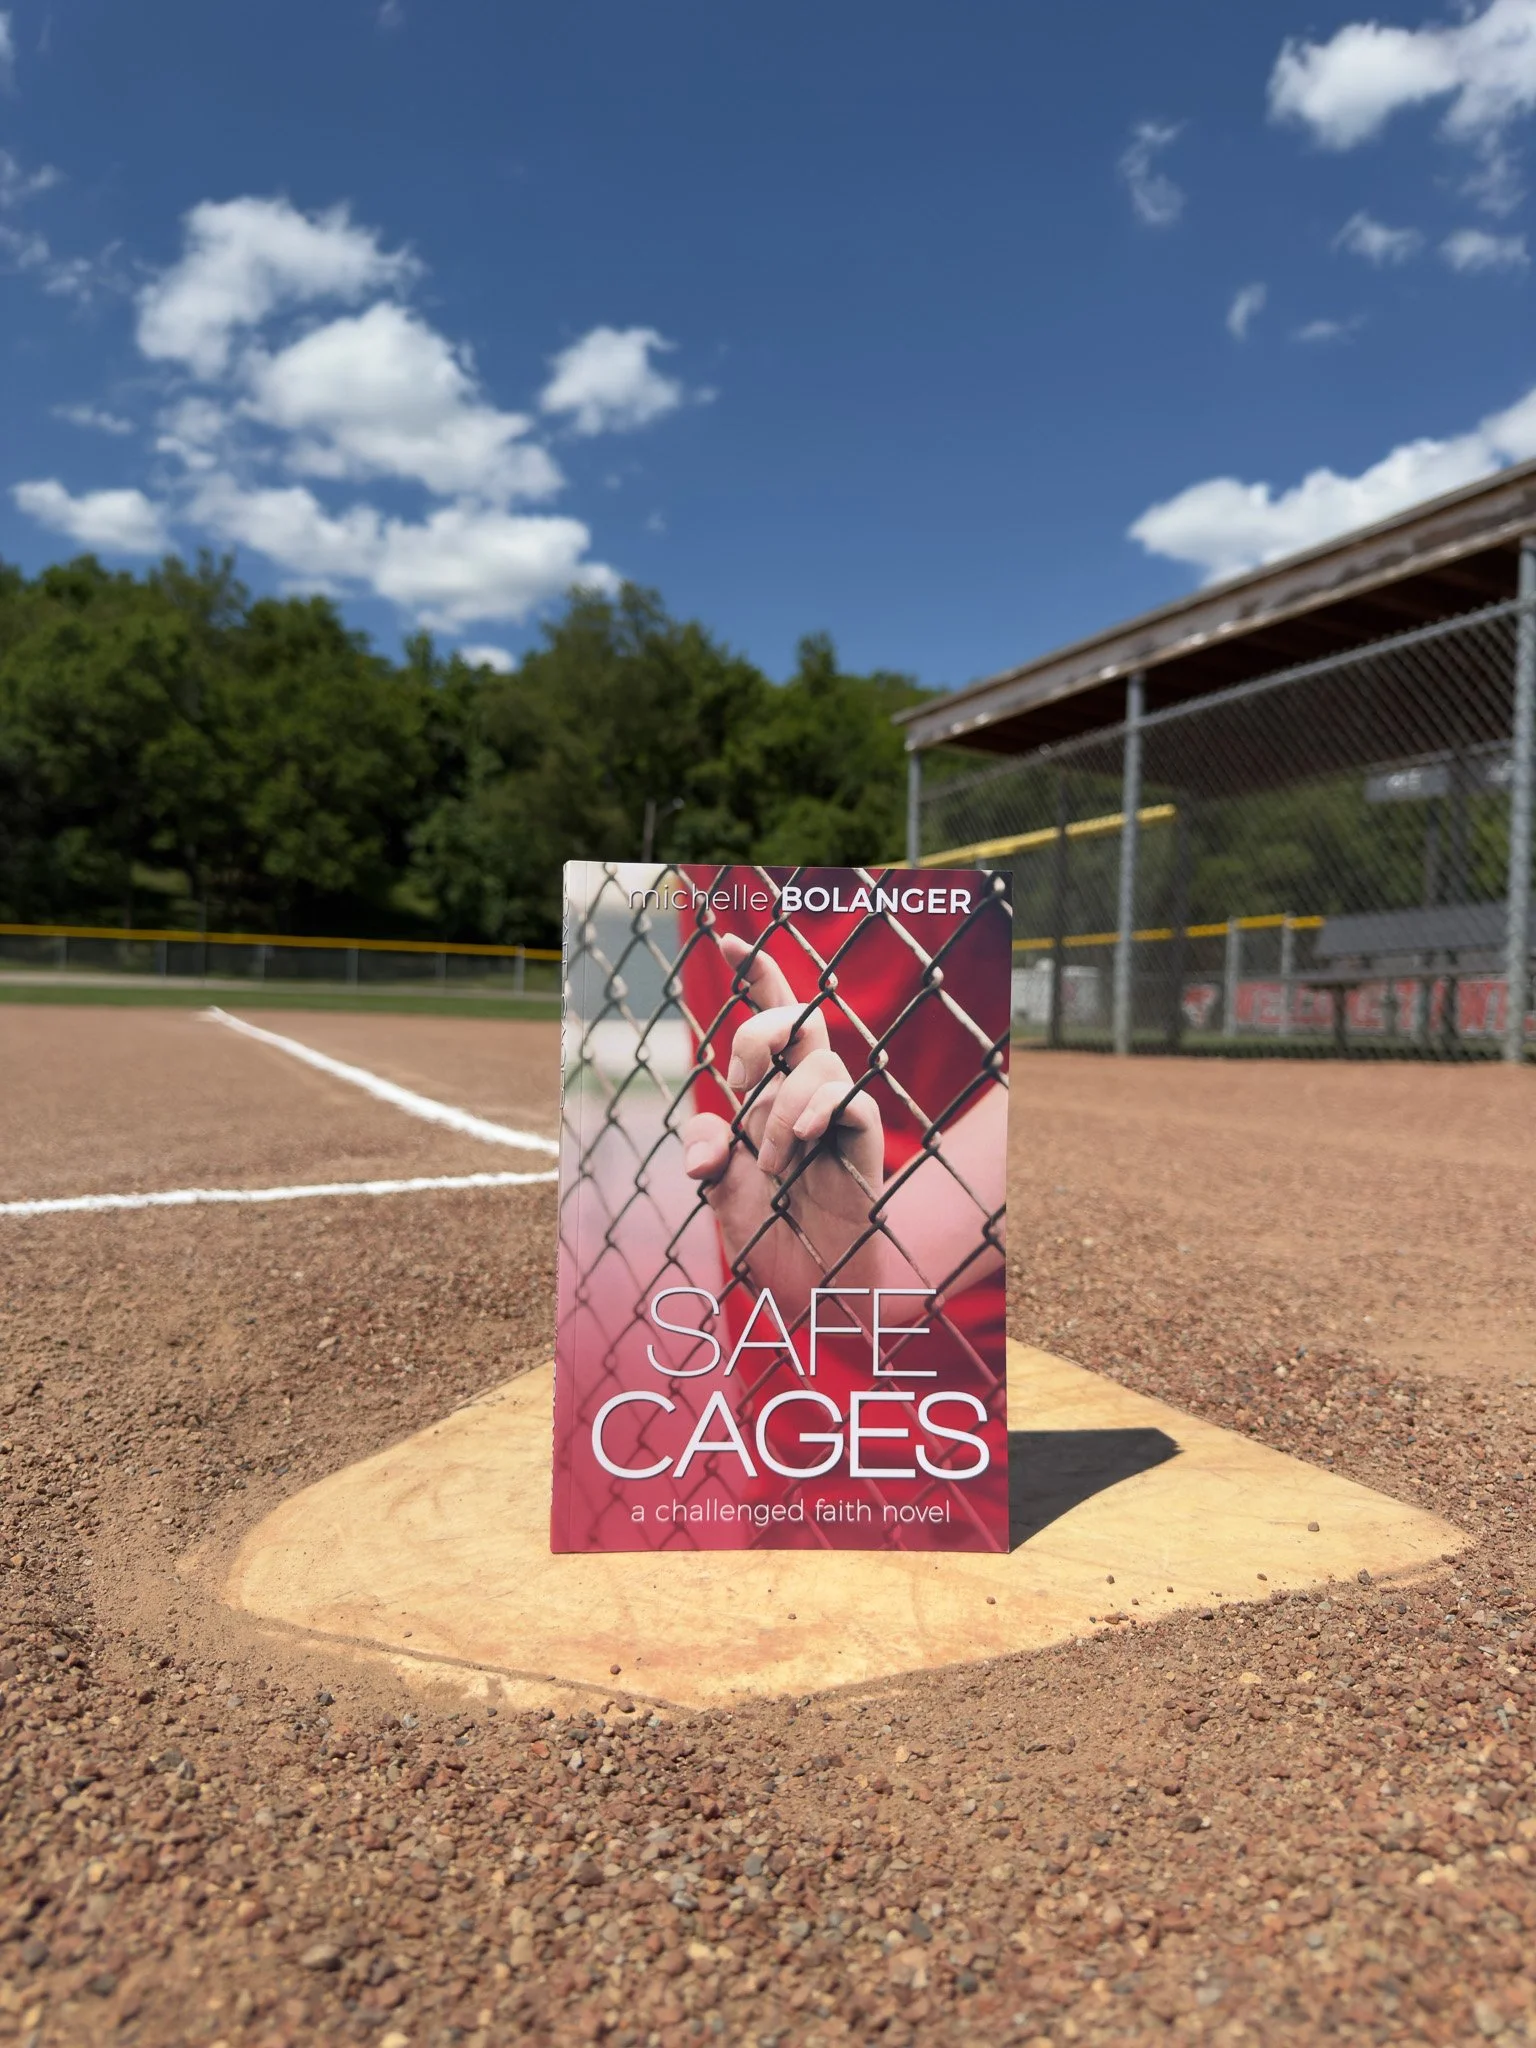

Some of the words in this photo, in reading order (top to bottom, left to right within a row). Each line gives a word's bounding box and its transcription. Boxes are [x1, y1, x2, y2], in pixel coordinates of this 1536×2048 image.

[629, 883, 768, 912] michelle
[781, 886, 972, 914] BOLANGER
[646, 1286, 938, 1379] SAFE
[591, 1390, 991, 1480] CAGES
[630, 1504, 646, 1523] a
[655, 1498, 804, 1528] challenged
[815, 1498, 872, 1523] faith
[882, 1499, 951, 1524] novel
